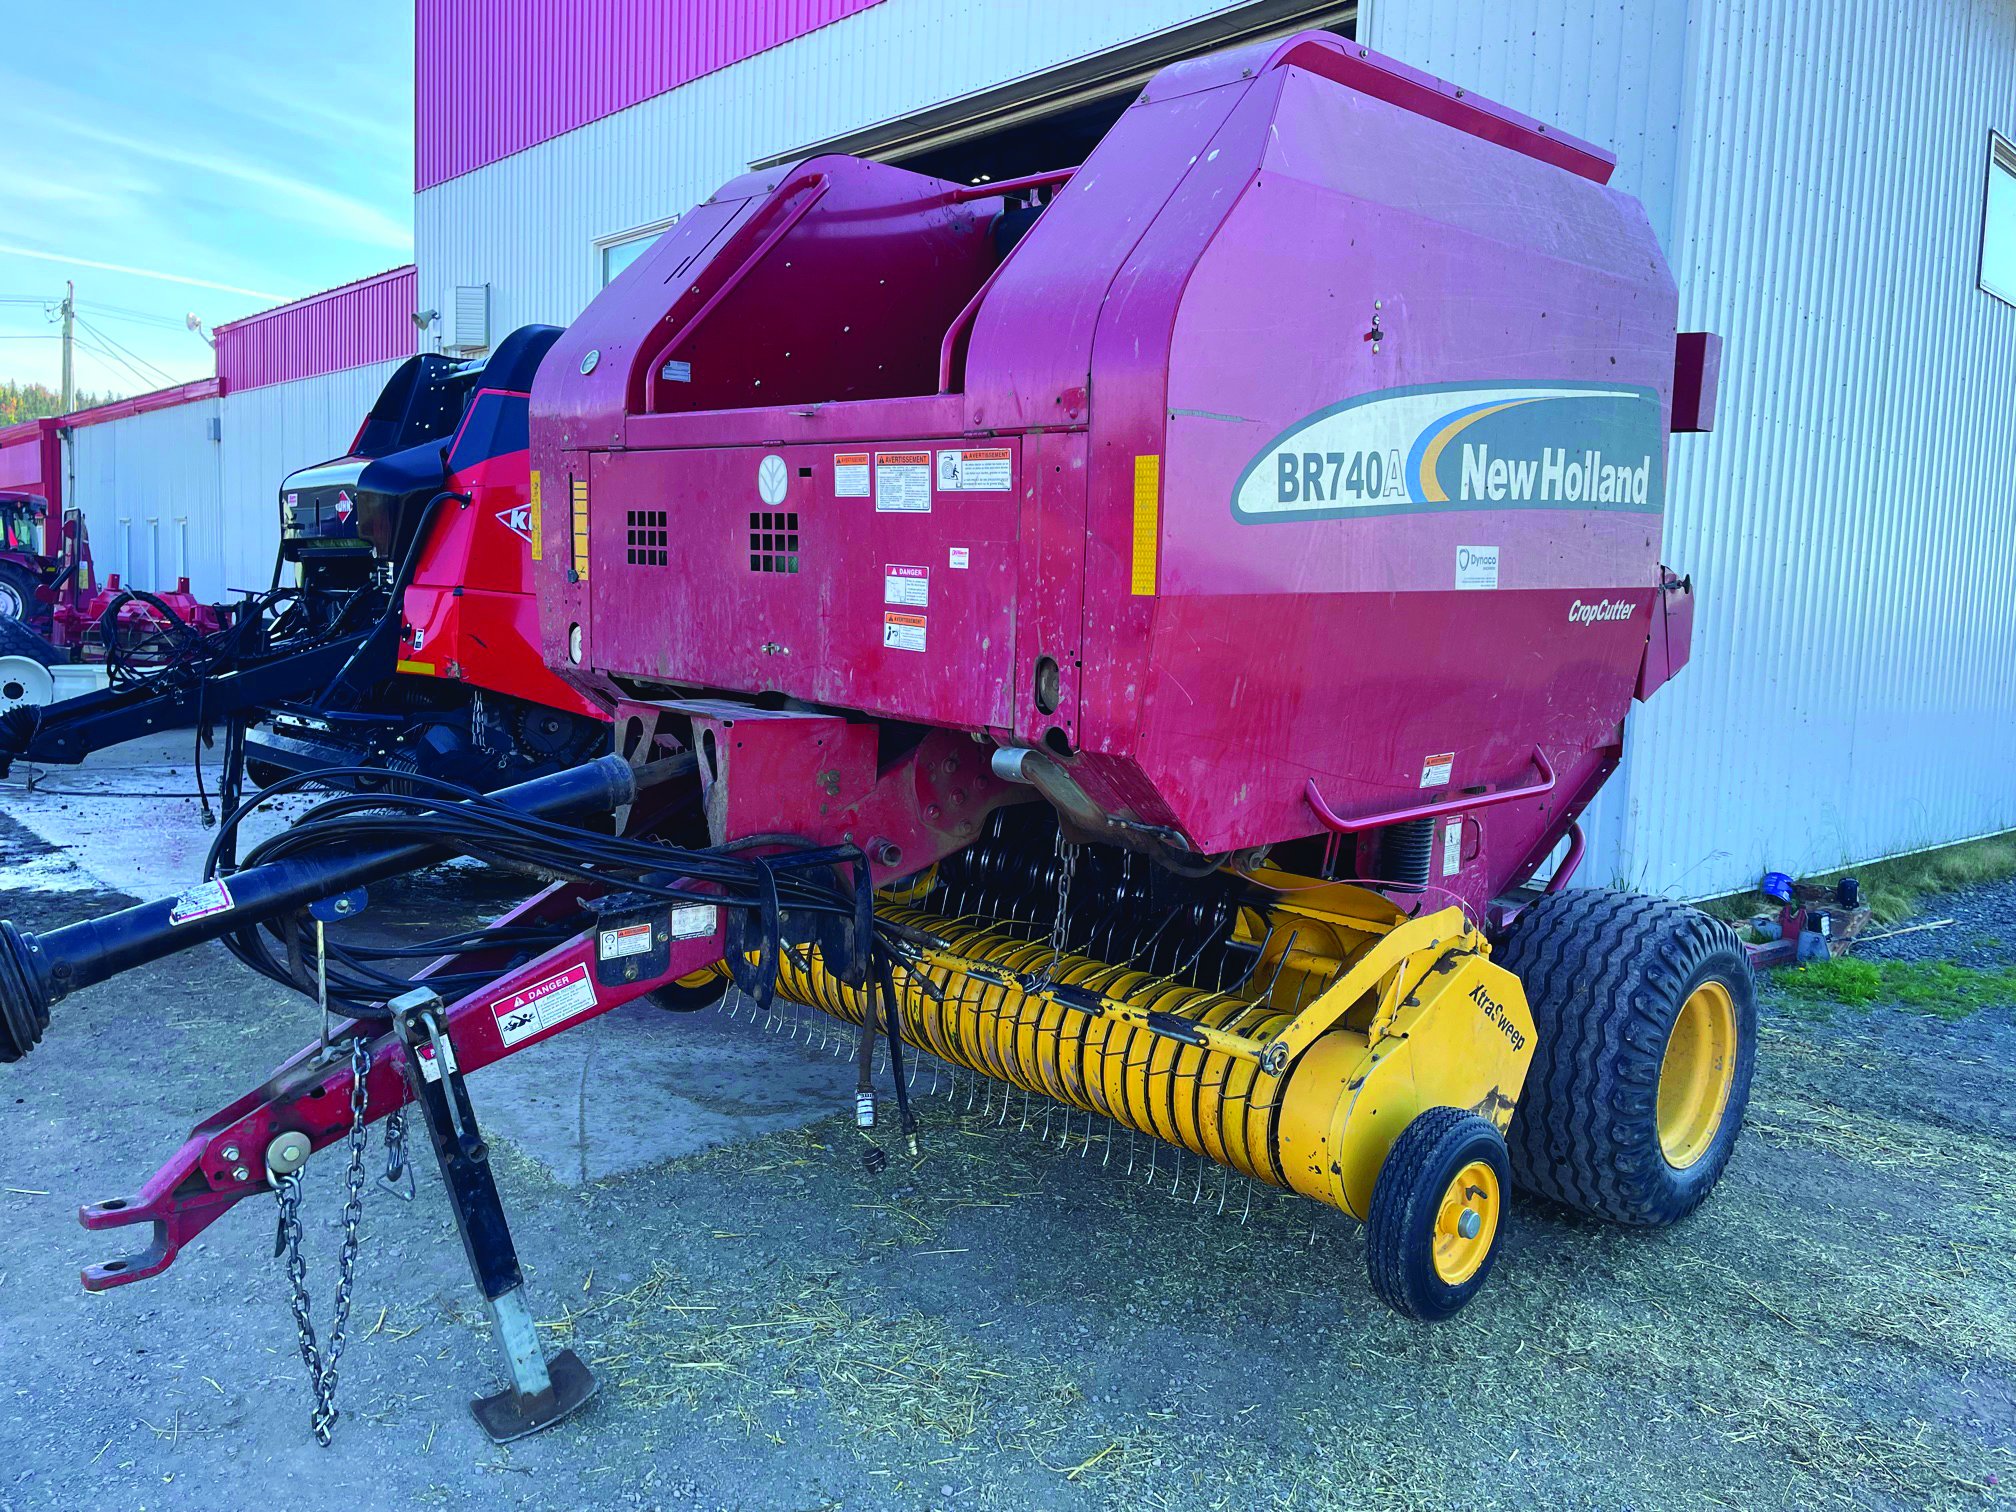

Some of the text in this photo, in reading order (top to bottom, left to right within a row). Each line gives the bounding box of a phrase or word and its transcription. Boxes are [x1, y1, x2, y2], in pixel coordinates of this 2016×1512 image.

[885, 455, 927, 464] AVERTISSEMENT
[969, 451, 1008, 459] AVERTISSEMENT
[1277, 448, 1406, 503] BR740A
[1460, 443, 1651, 505] New Holland
[899, 568, 923, 576] DANGER
[1470, 554, 1497, 567] Dynaco
[1568, 598, 1637, 627] CropCutter
[527, 975, 571, 1001] DANGER
[1468, 984, 1526, 1052] XtraSweep
